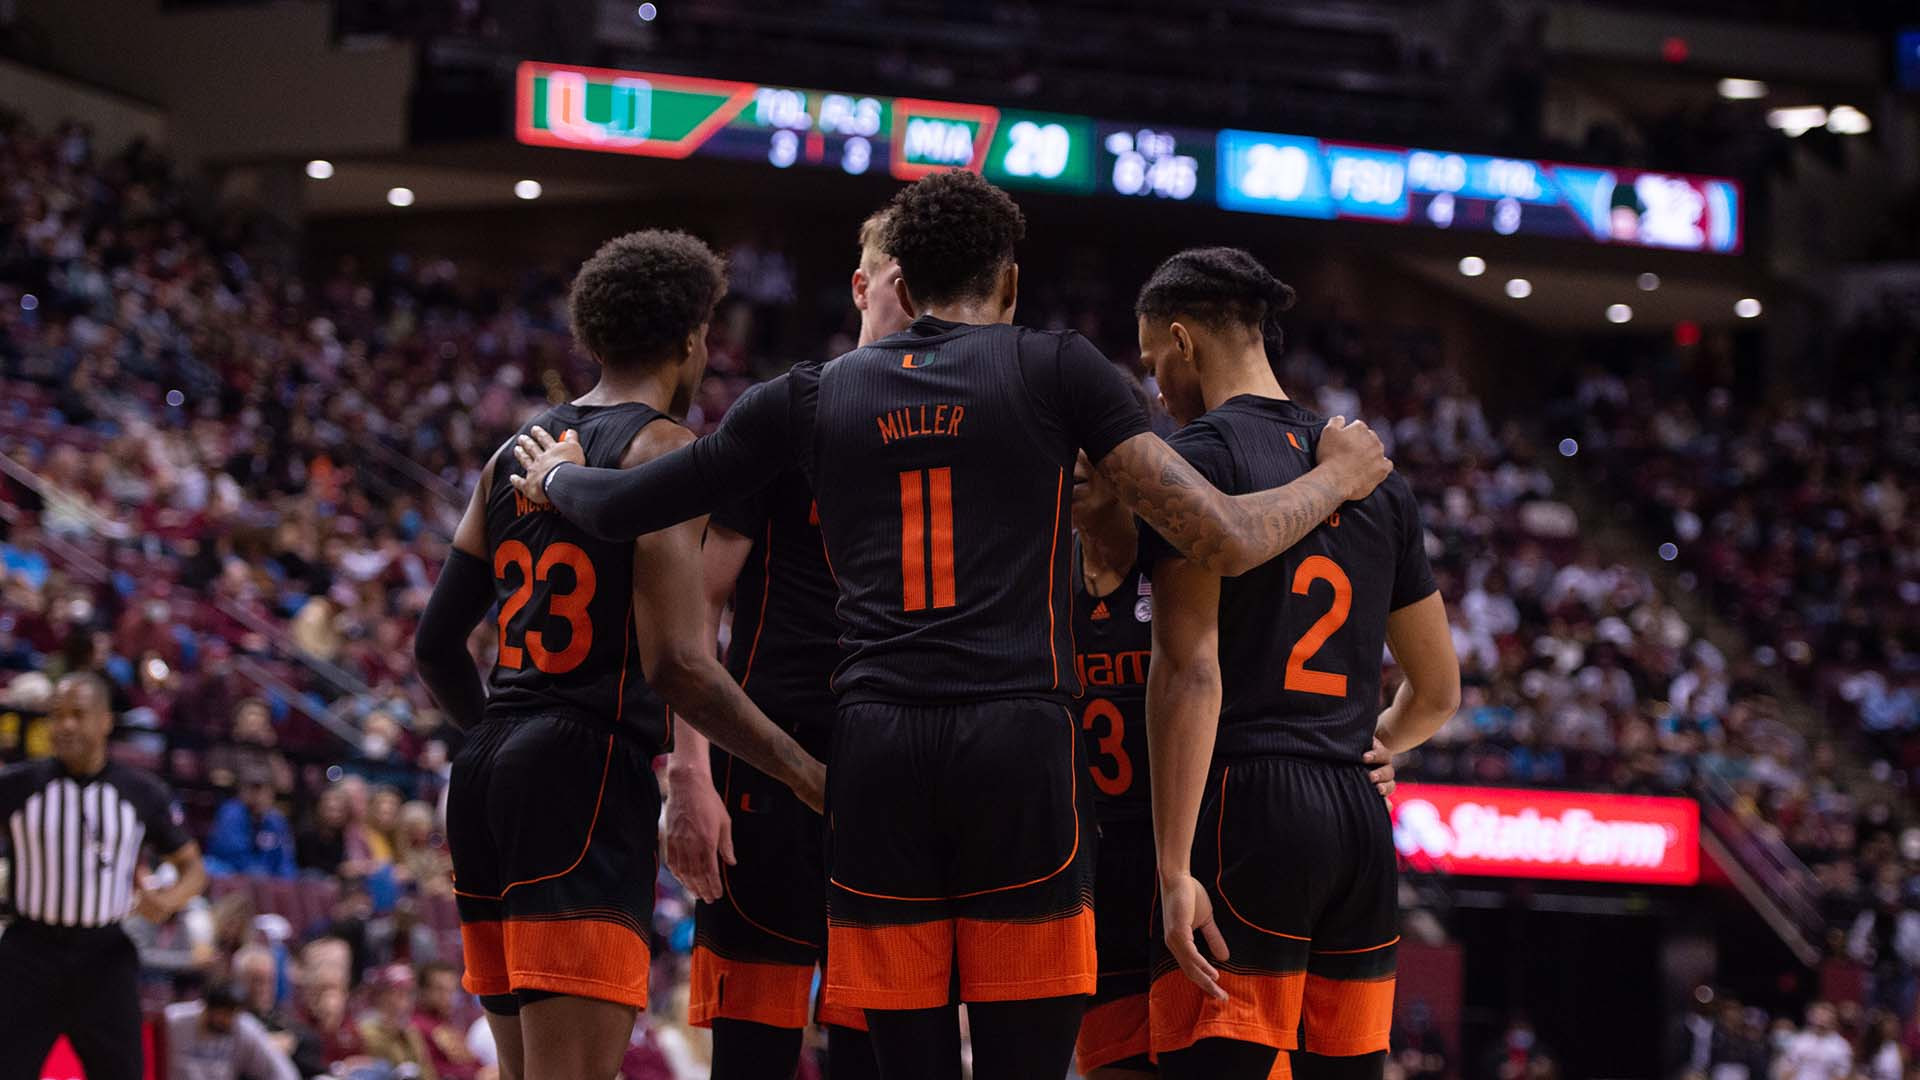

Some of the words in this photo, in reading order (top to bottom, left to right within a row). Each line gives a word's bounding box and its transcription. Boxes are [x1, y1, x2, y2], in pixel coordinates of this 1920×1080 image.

[546, 71, 652, 146] U
[1003, 121, 1070, 178] 20
[1241, 143, 1309, 201] 20
[1331, 157, 1405, 204] FSU
[876, 404, 965, 444] MILLER
[900, 466, 956, 611] 11
[494, 539, 597, 674] 23
[1284, 555, 1353, 697] 2
[1083, 698, 1134, 796] 3
